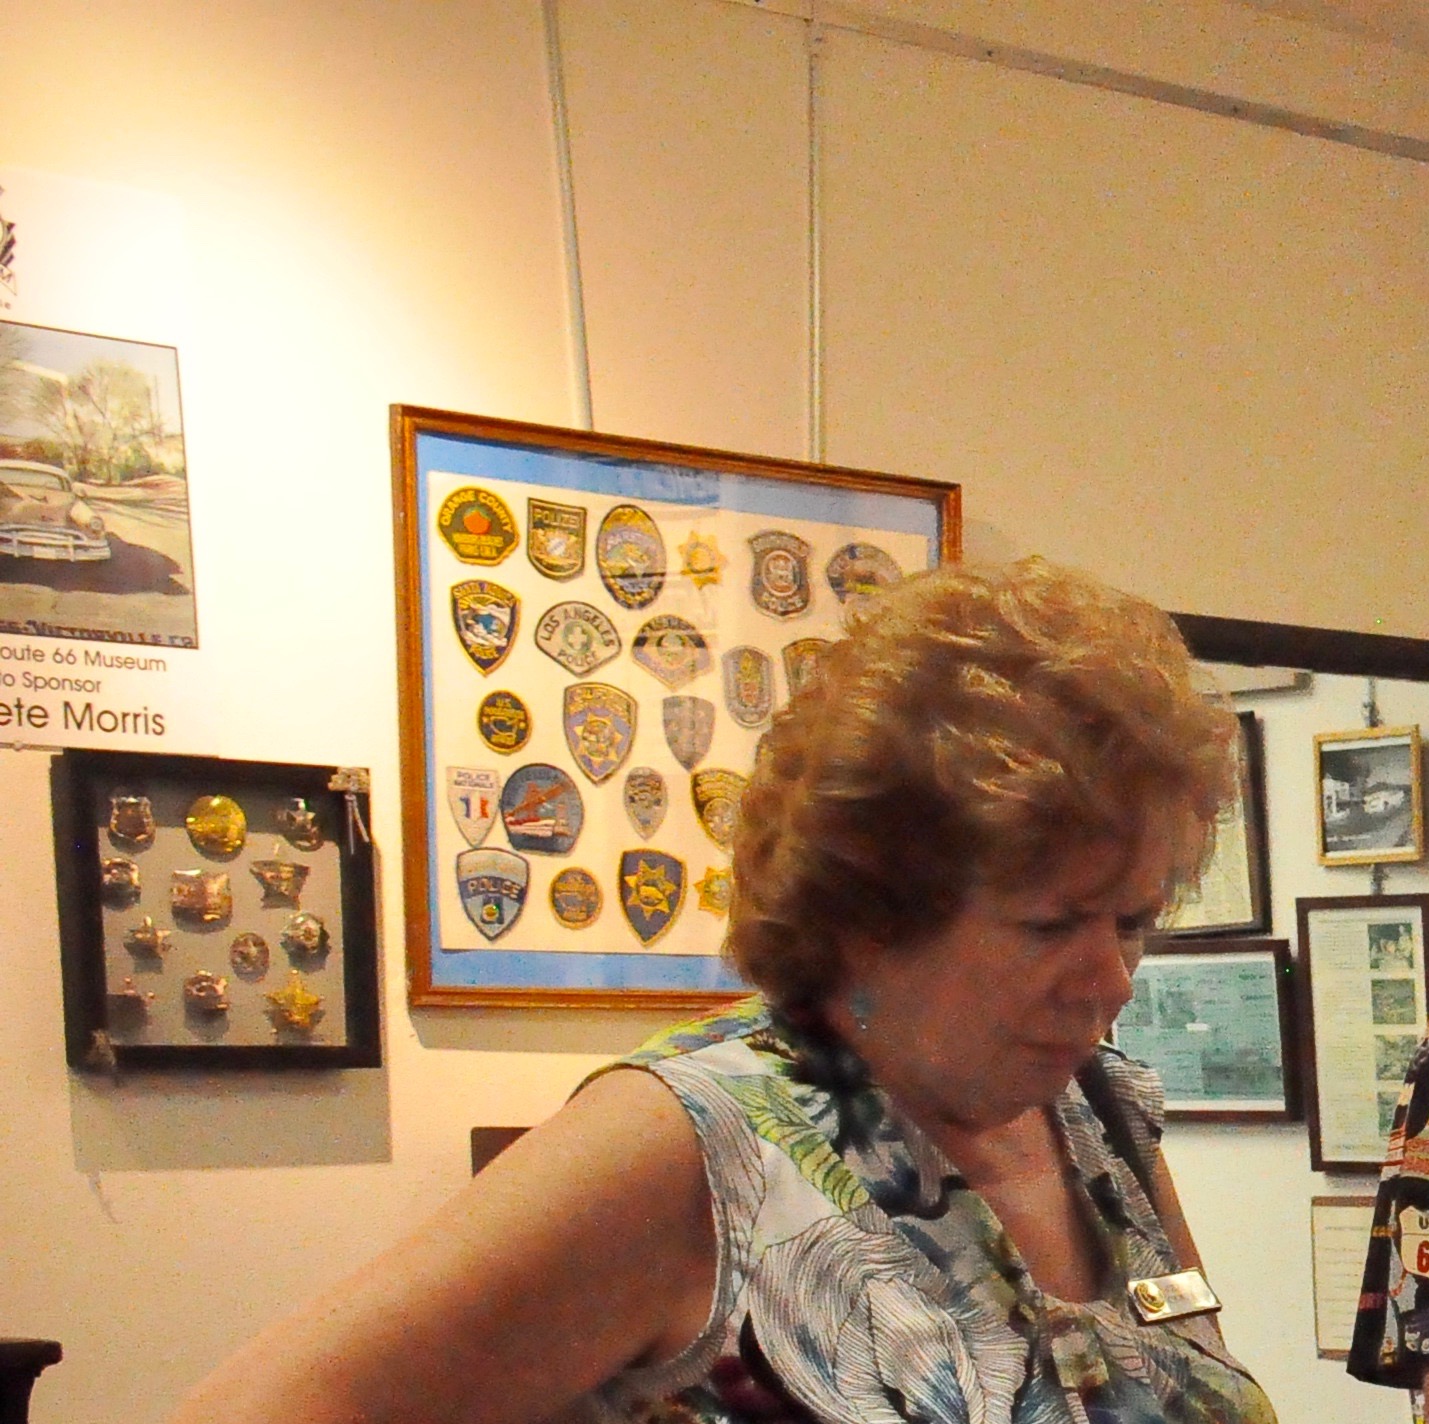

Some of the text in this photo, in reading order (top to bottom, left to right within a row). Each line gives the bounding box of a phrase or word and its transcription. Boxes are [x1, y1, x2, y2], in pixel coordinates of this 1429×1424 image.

[439, 490, 514, 533] ORANGE COUNTY
[532, 507, 580, 530] POLIZEI
[539, 615, 561, 641] LOS
[562, 606, 617, 648] ANGELES
[0, 645, 169, 672] oute 66 Museum
[557, 648, 599, 667] POLICE
[23, 670, 102, 694] Sponsor
[63, 700, 166, 736] Morris
[466, 878, 520, 901] POLICE
